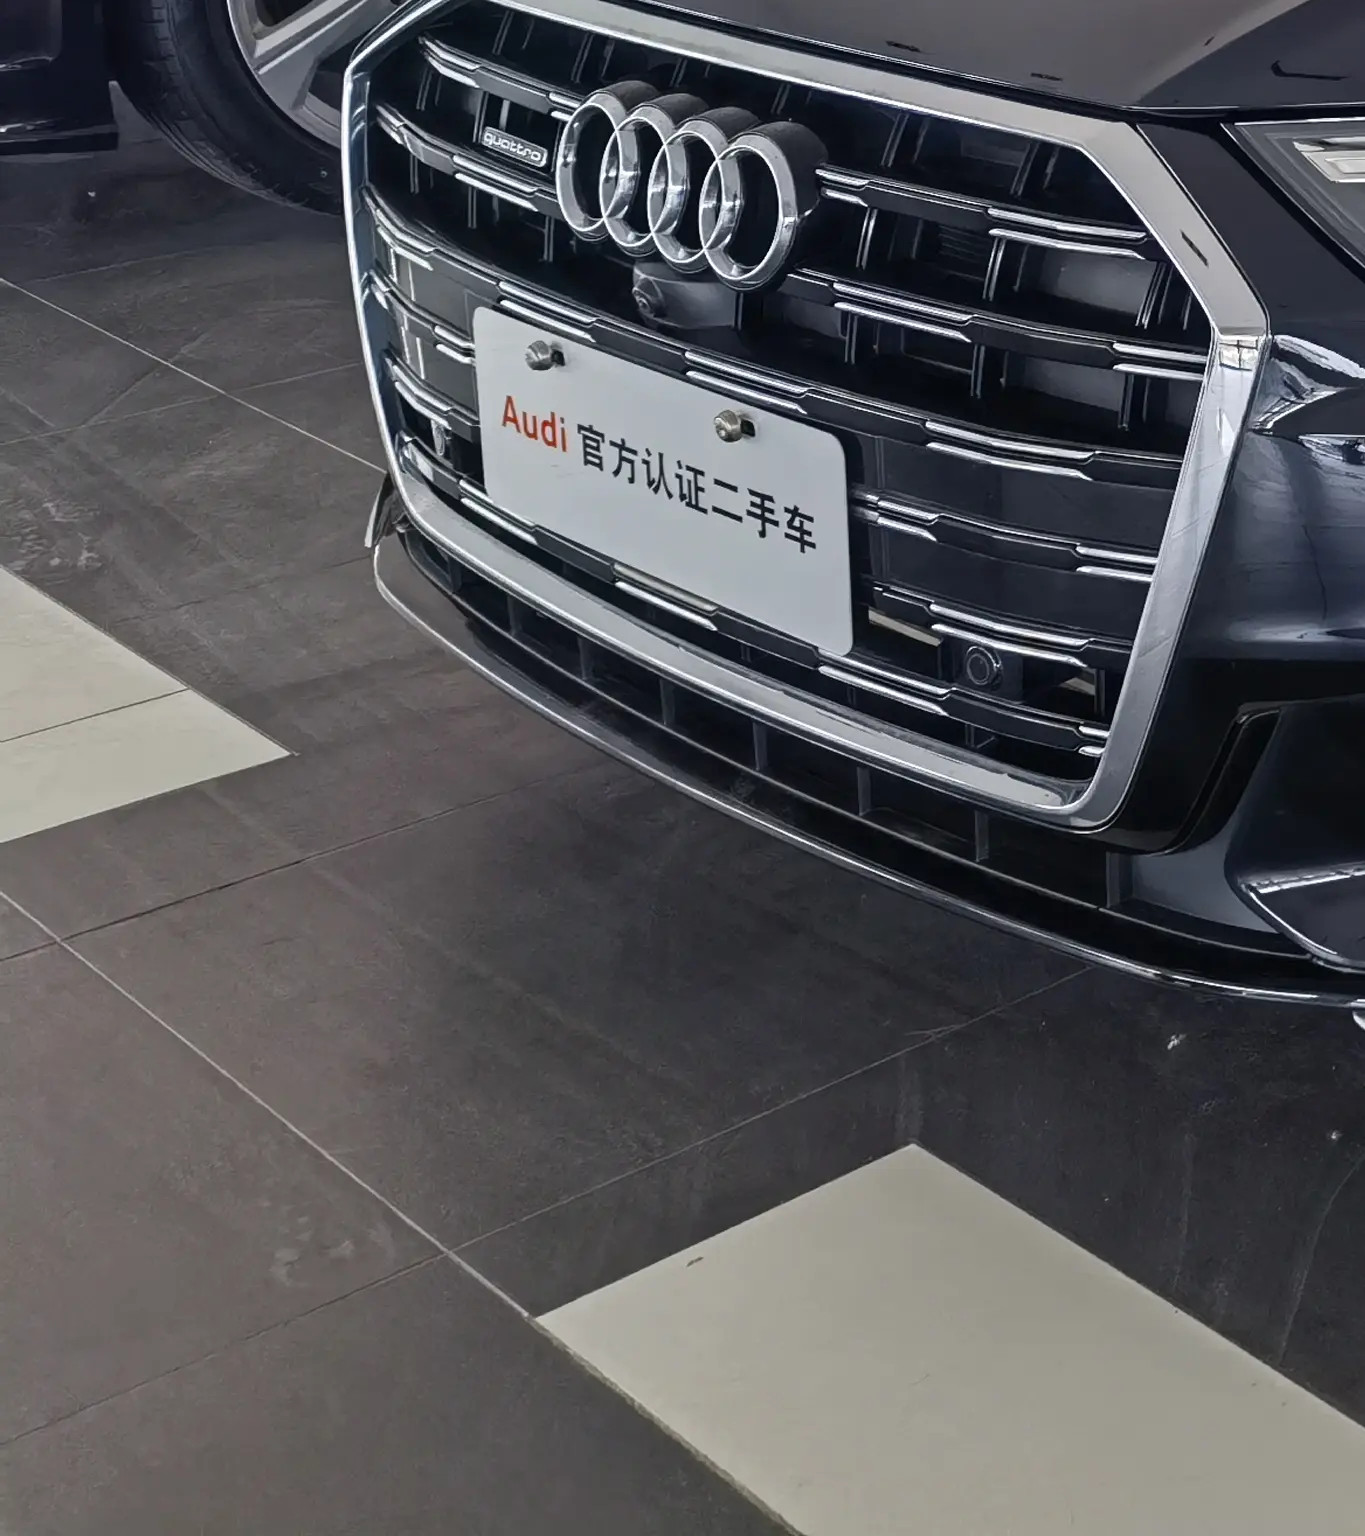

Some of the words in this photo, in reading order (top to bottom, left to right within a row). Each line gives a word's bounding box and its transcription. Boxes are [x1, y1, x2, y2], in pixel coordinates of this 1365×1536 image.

[482, 131, 542, 162] quattro
[501, 395, 567, 453] Audi
[577, 423, 817, 554] 官方认证二手车
